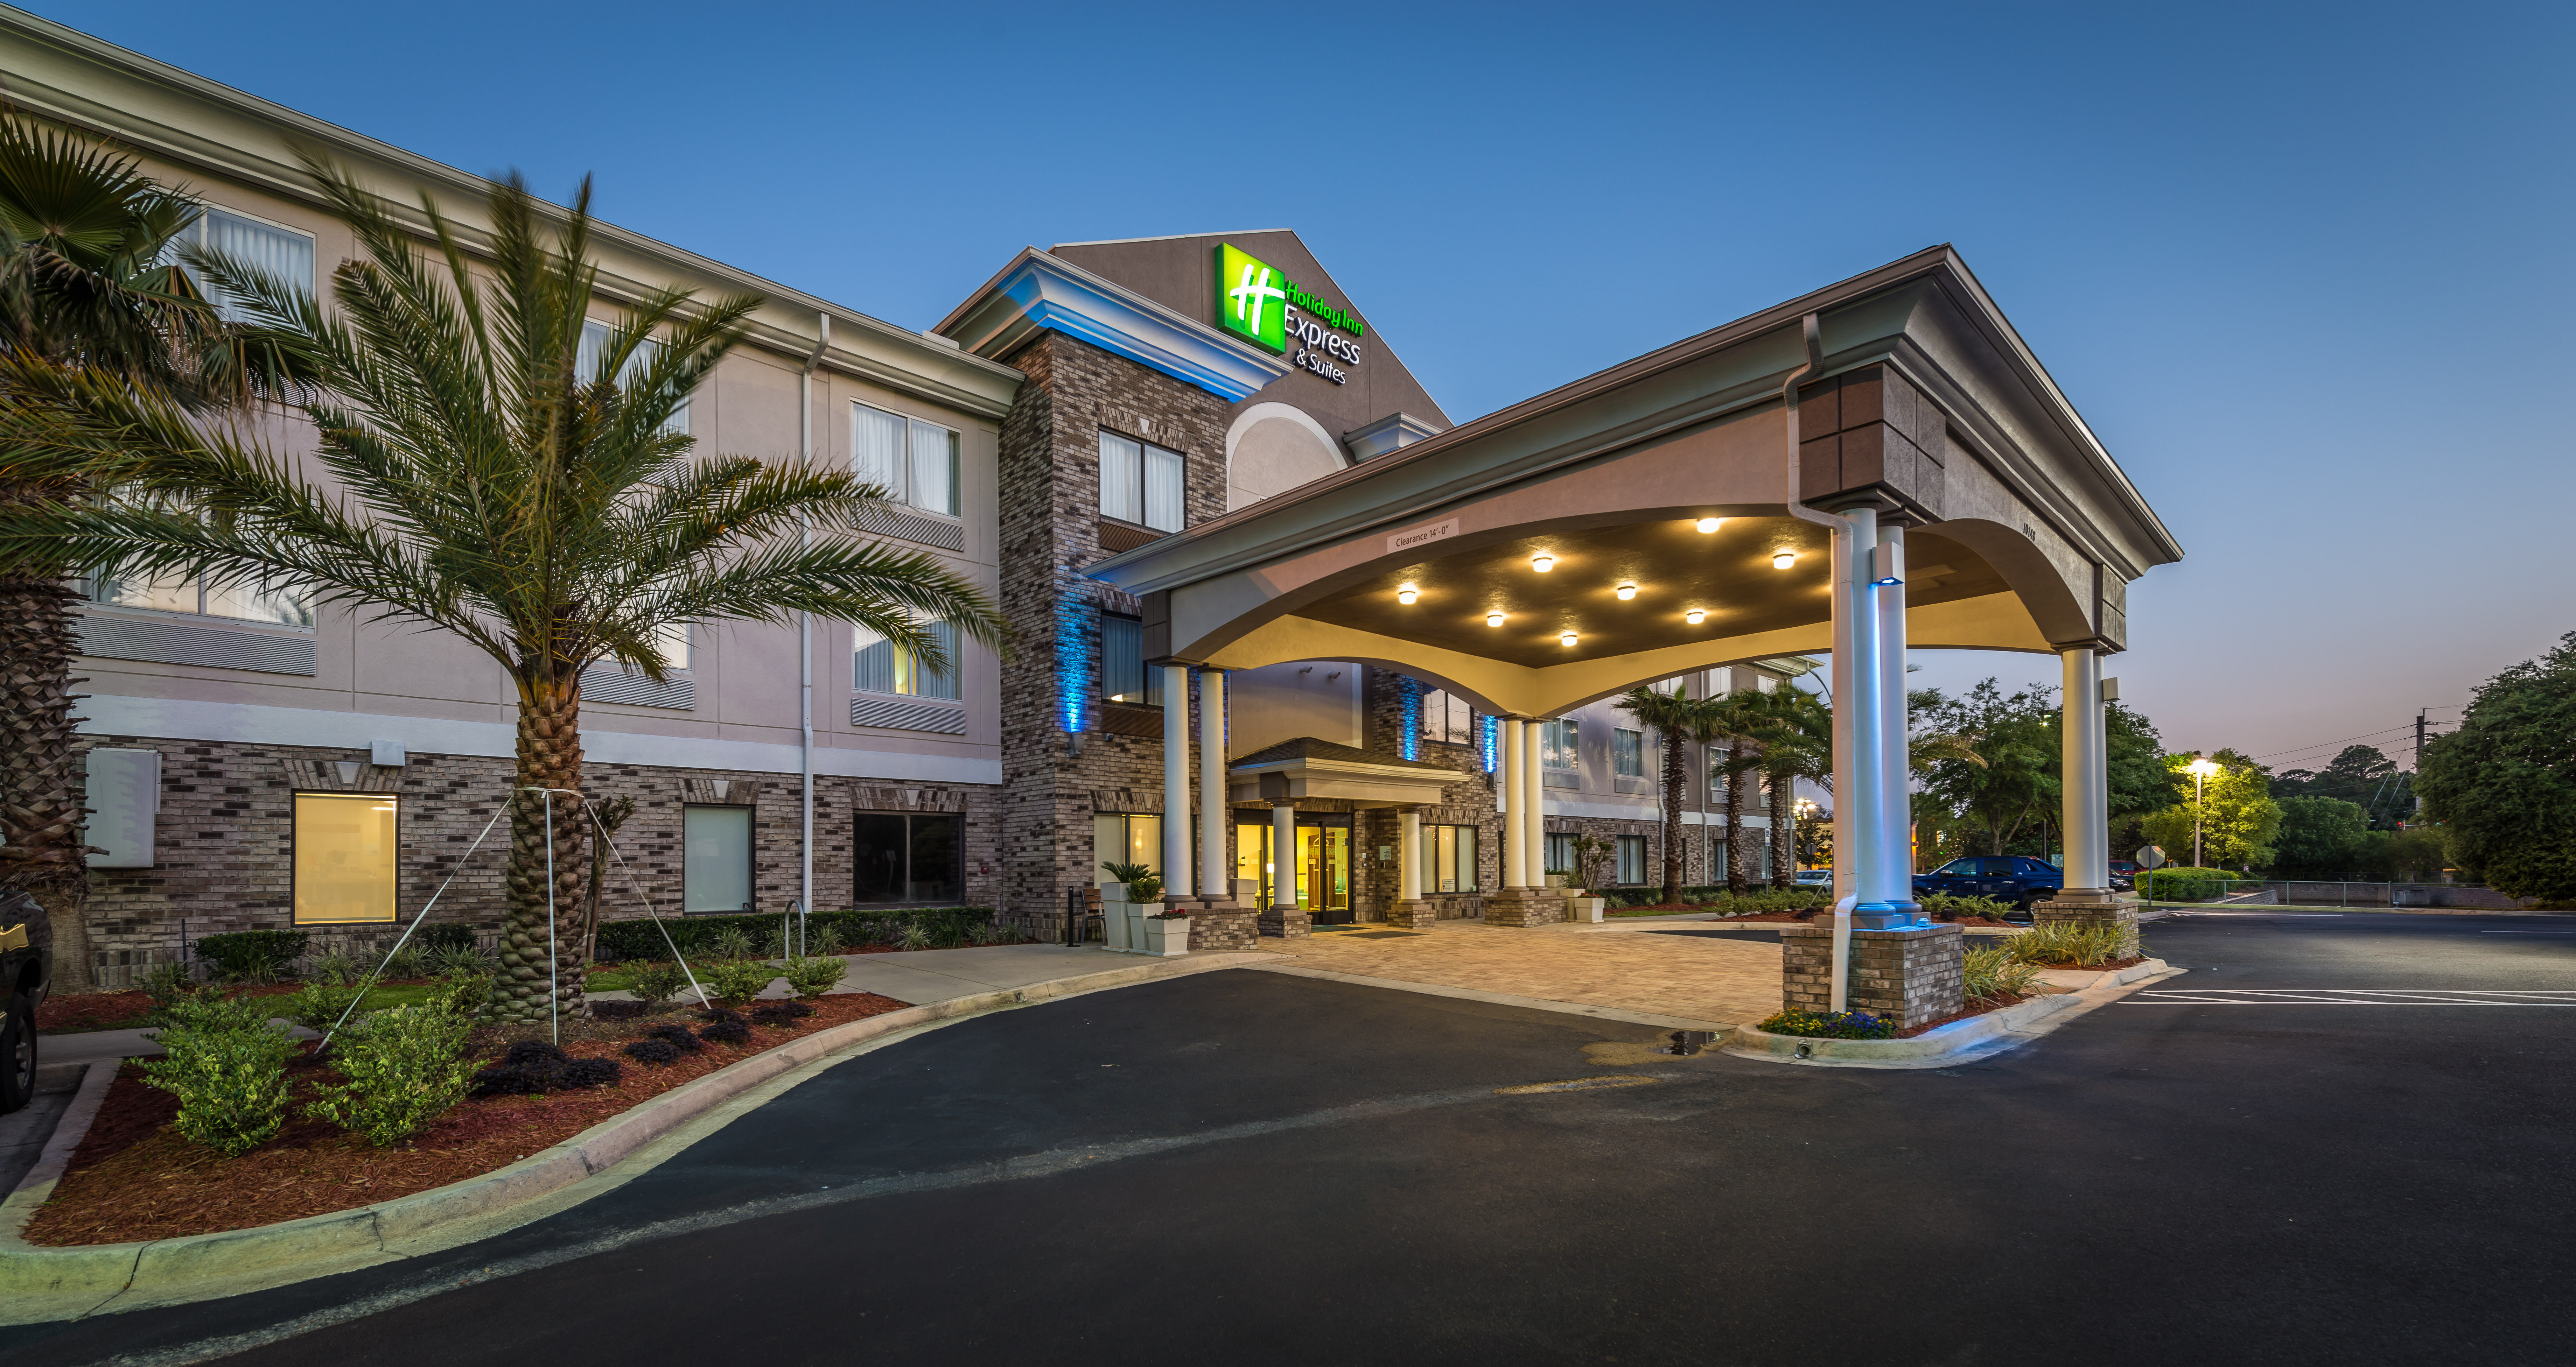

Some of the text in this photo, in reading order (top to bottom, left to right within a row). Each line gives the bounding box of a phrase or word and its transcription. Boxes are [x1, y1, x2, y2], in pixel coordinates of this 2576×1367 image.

[1286, 280, 1363, 337] Holiday Inn
[1285, 303, 1360, 365] Express
[1297, 348, 1346, 385] & Suites
[1396, 533, 1427, 547] Clearance
[2023, 522, 2036, 542] 10148
